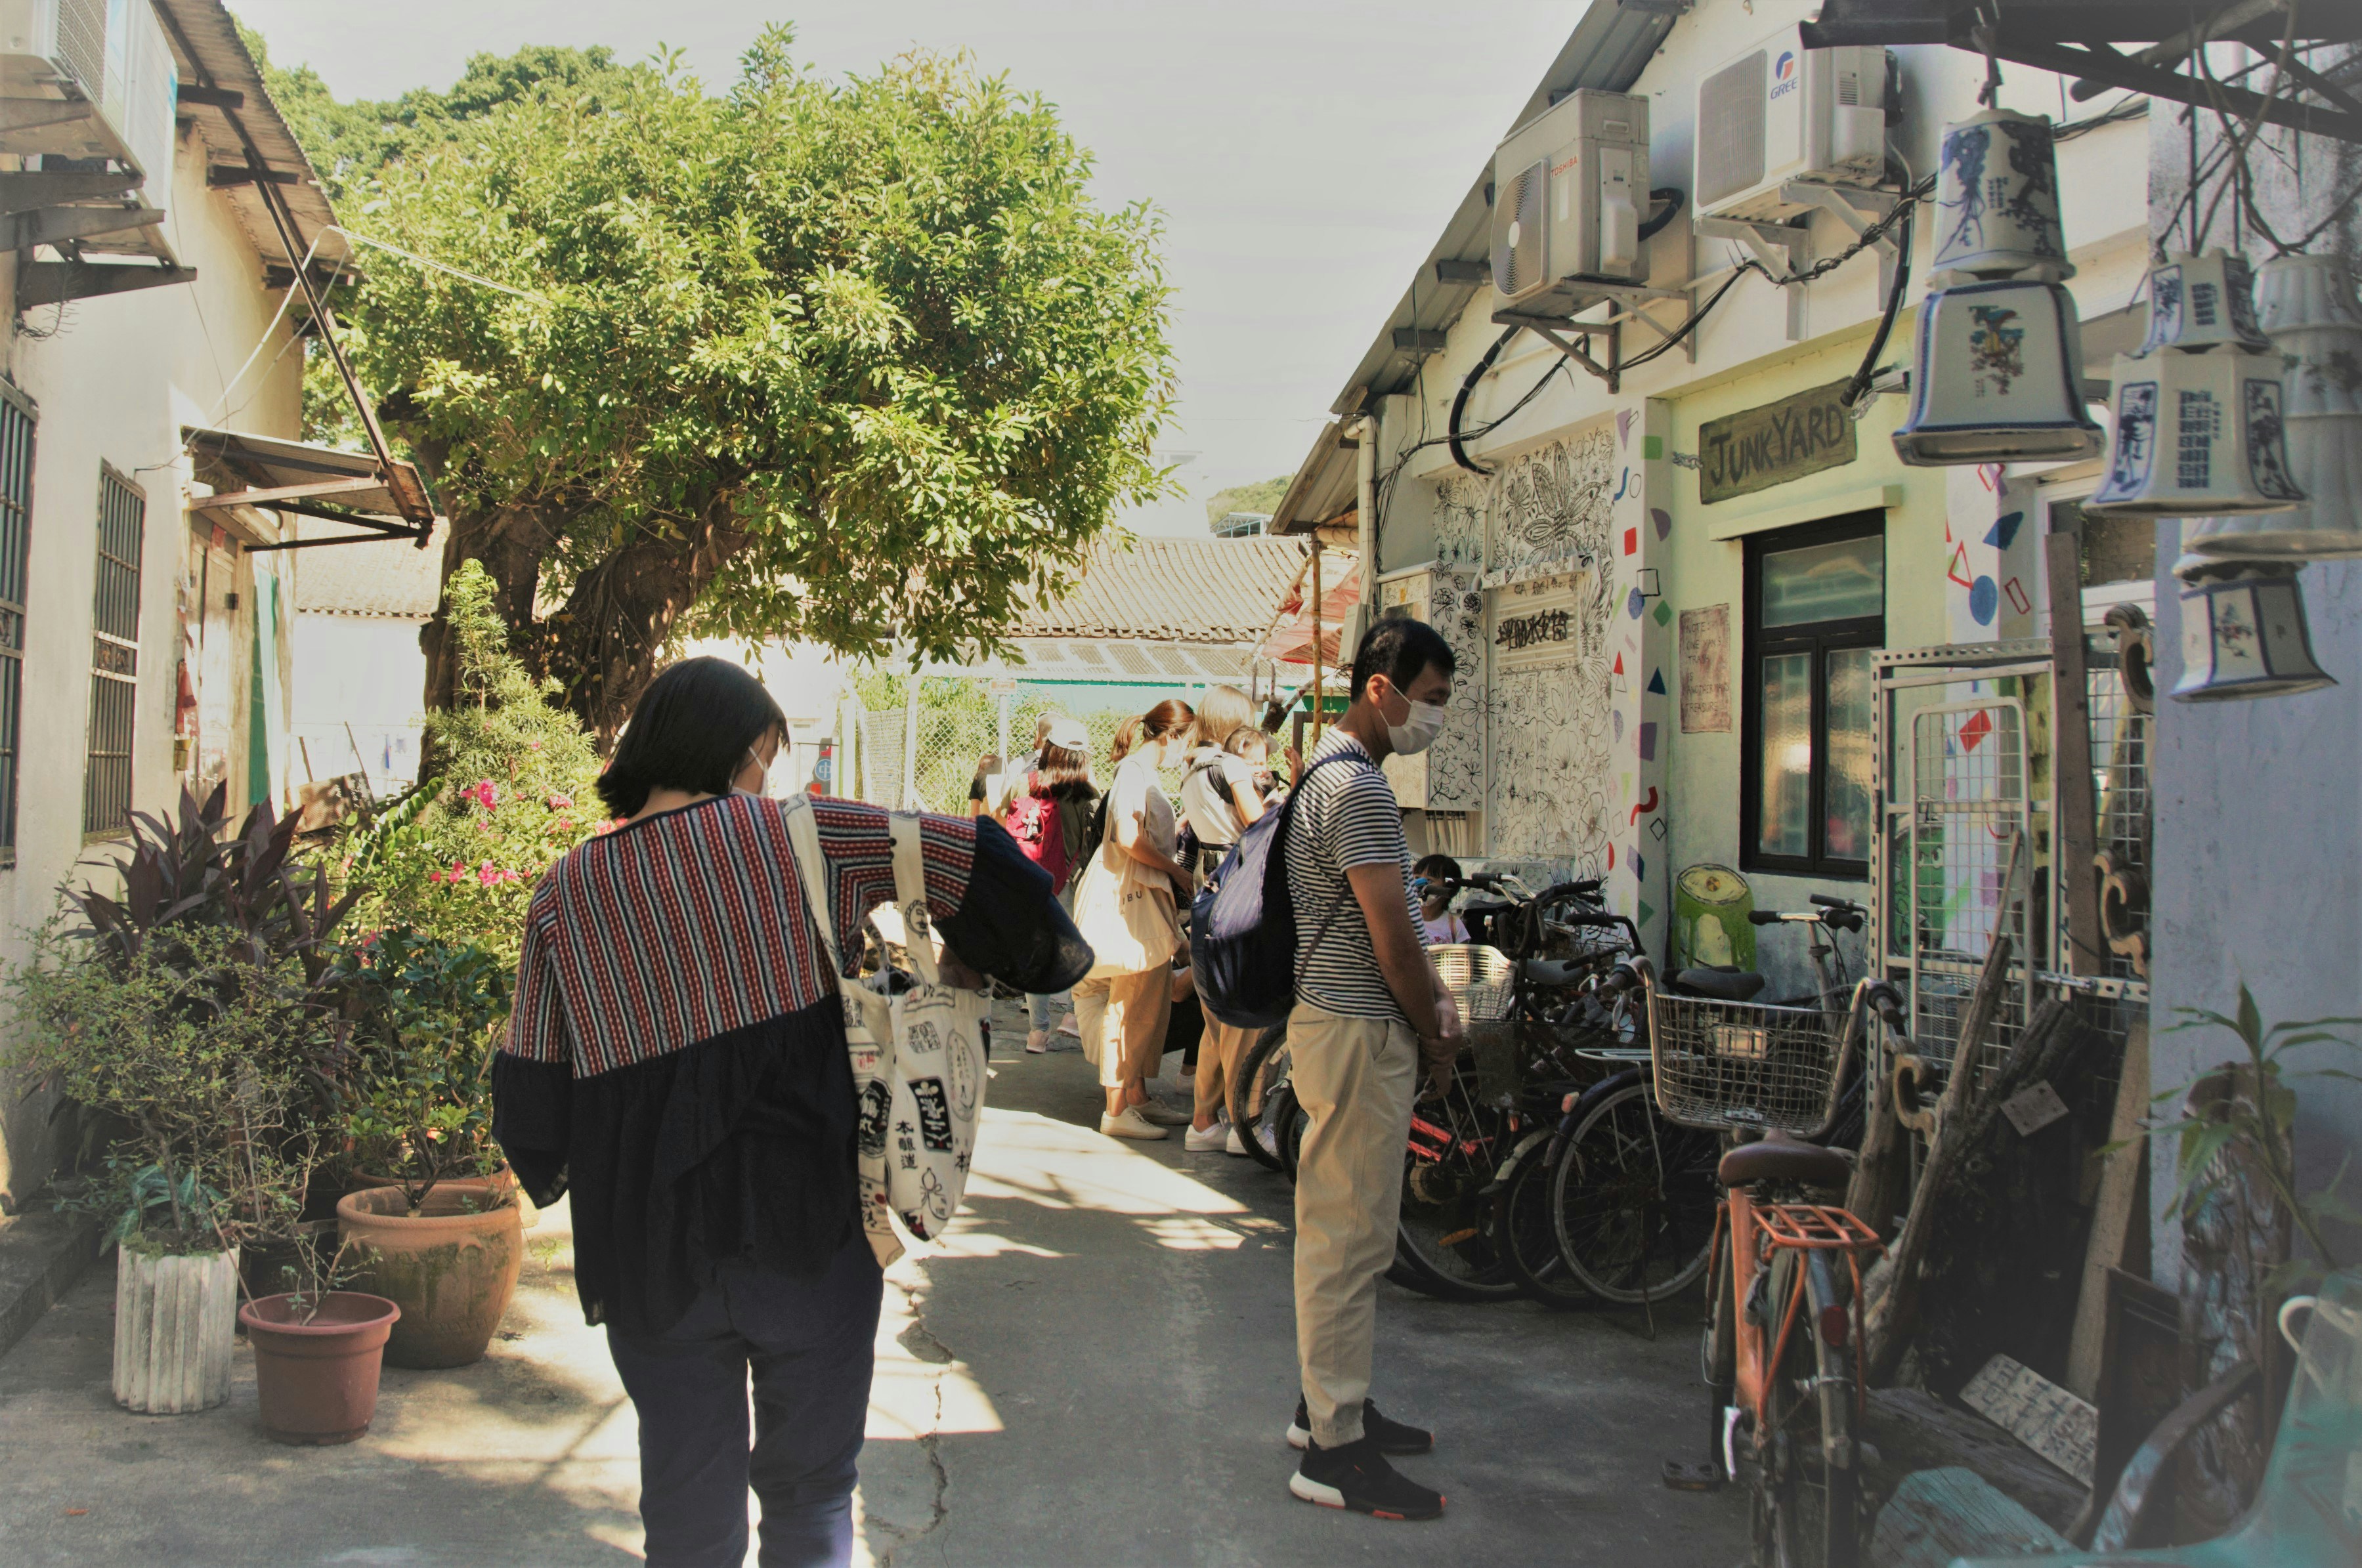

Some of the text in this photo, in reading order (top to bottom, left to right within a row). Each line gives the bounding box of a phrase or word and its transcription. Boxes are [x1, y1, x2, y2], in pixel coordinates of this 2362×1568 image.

[1771, 77, 1798, 100] GREE
[1551, 156, 1578, 178] TOSHIBA
[1709, 404, 1845, 486] JUNKYARD
